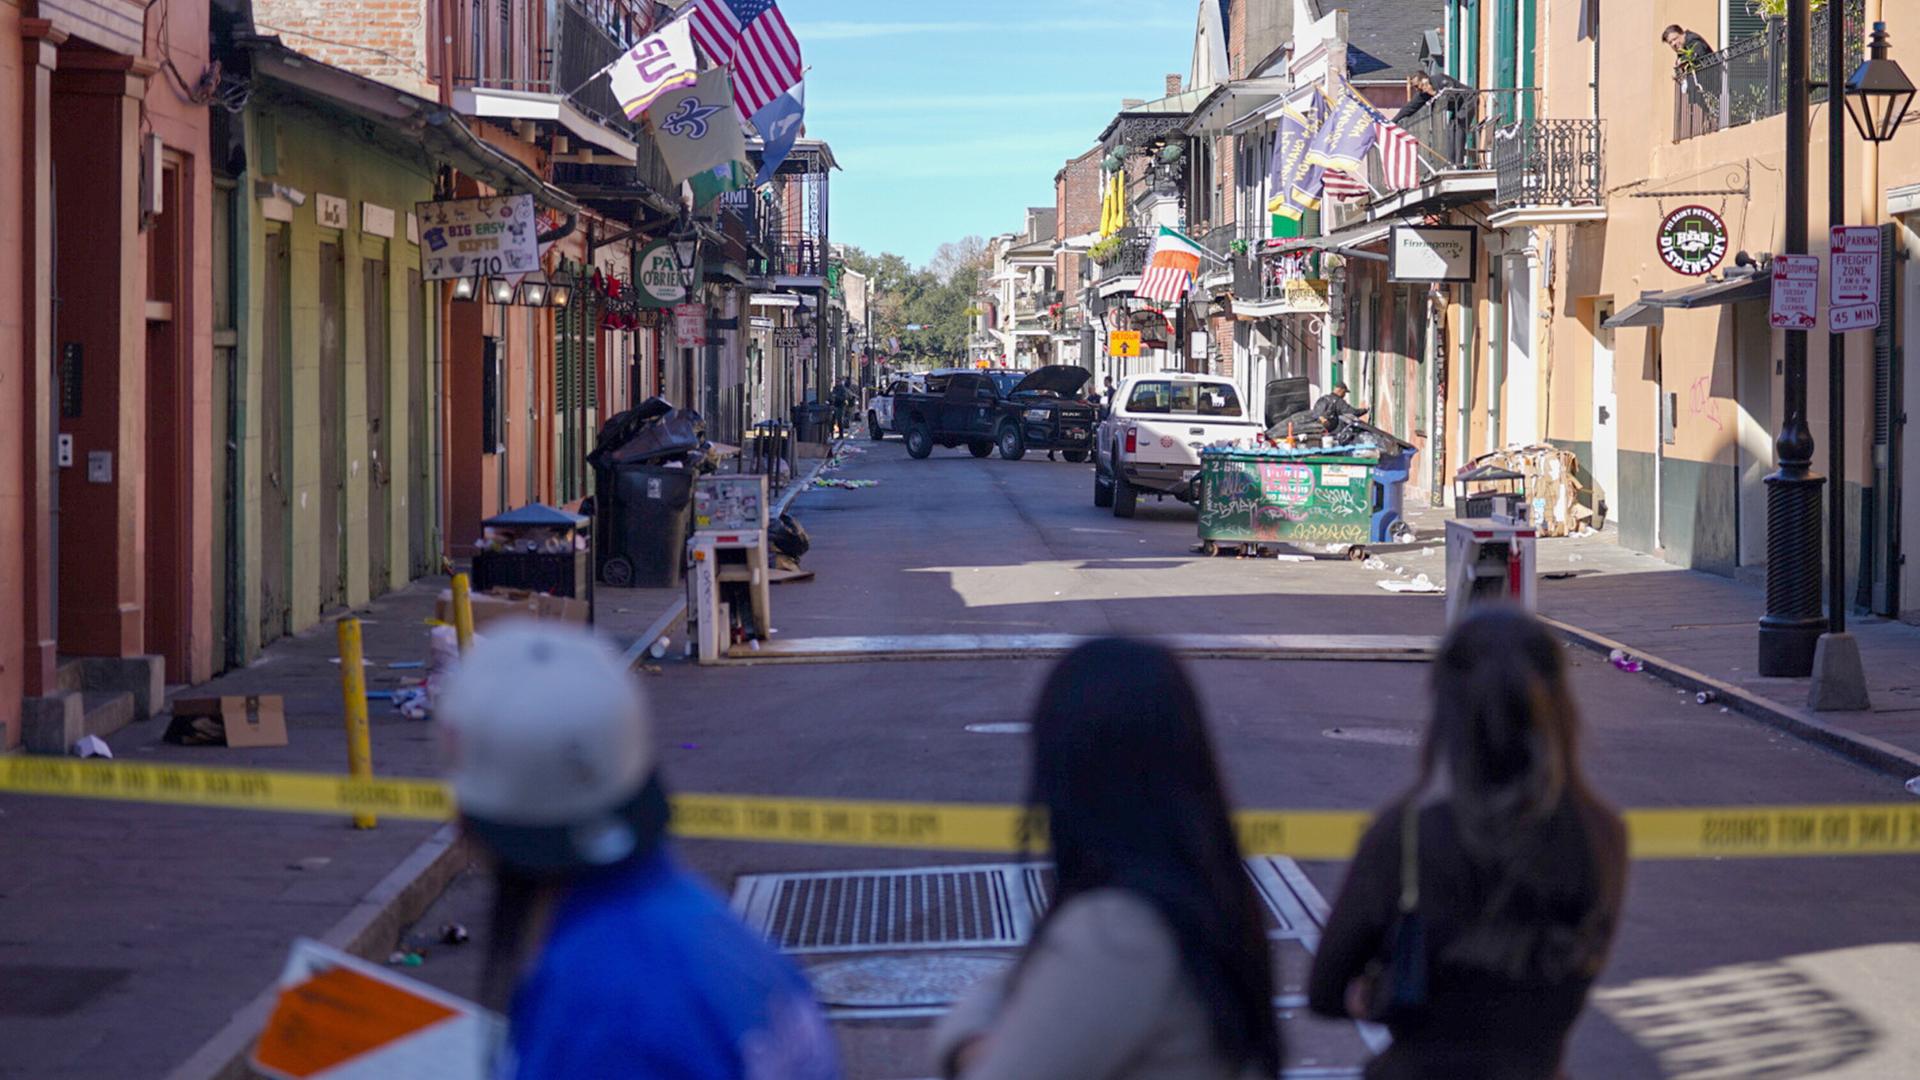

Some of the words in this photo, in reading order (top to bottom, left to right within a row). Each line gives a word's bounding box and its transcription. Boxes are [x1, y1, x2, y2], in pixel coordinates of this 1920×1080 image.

[1671, 209, 1692, 223] SAINT
[1693, 209, 1715, 221] PETER
[448, 225, 472, 237] BIG
[475, 222, 505, 235] EASY
[1832, 233, 1845, 248] NO
[1846, 236, 1878, 246] PARKING
[1660, 234, 1726, 274] DISPENSARY
[1836, 255, 1872, 265] FREIGHT
[1775, 262, 1787, 274] NO
[1787, 264, 1818, 273] STOPPING
[1842, 266, 1866, 276] ZONE
[1835, 312, 1848, 323] 45
[1855, 309, 1873, 320] MIN
